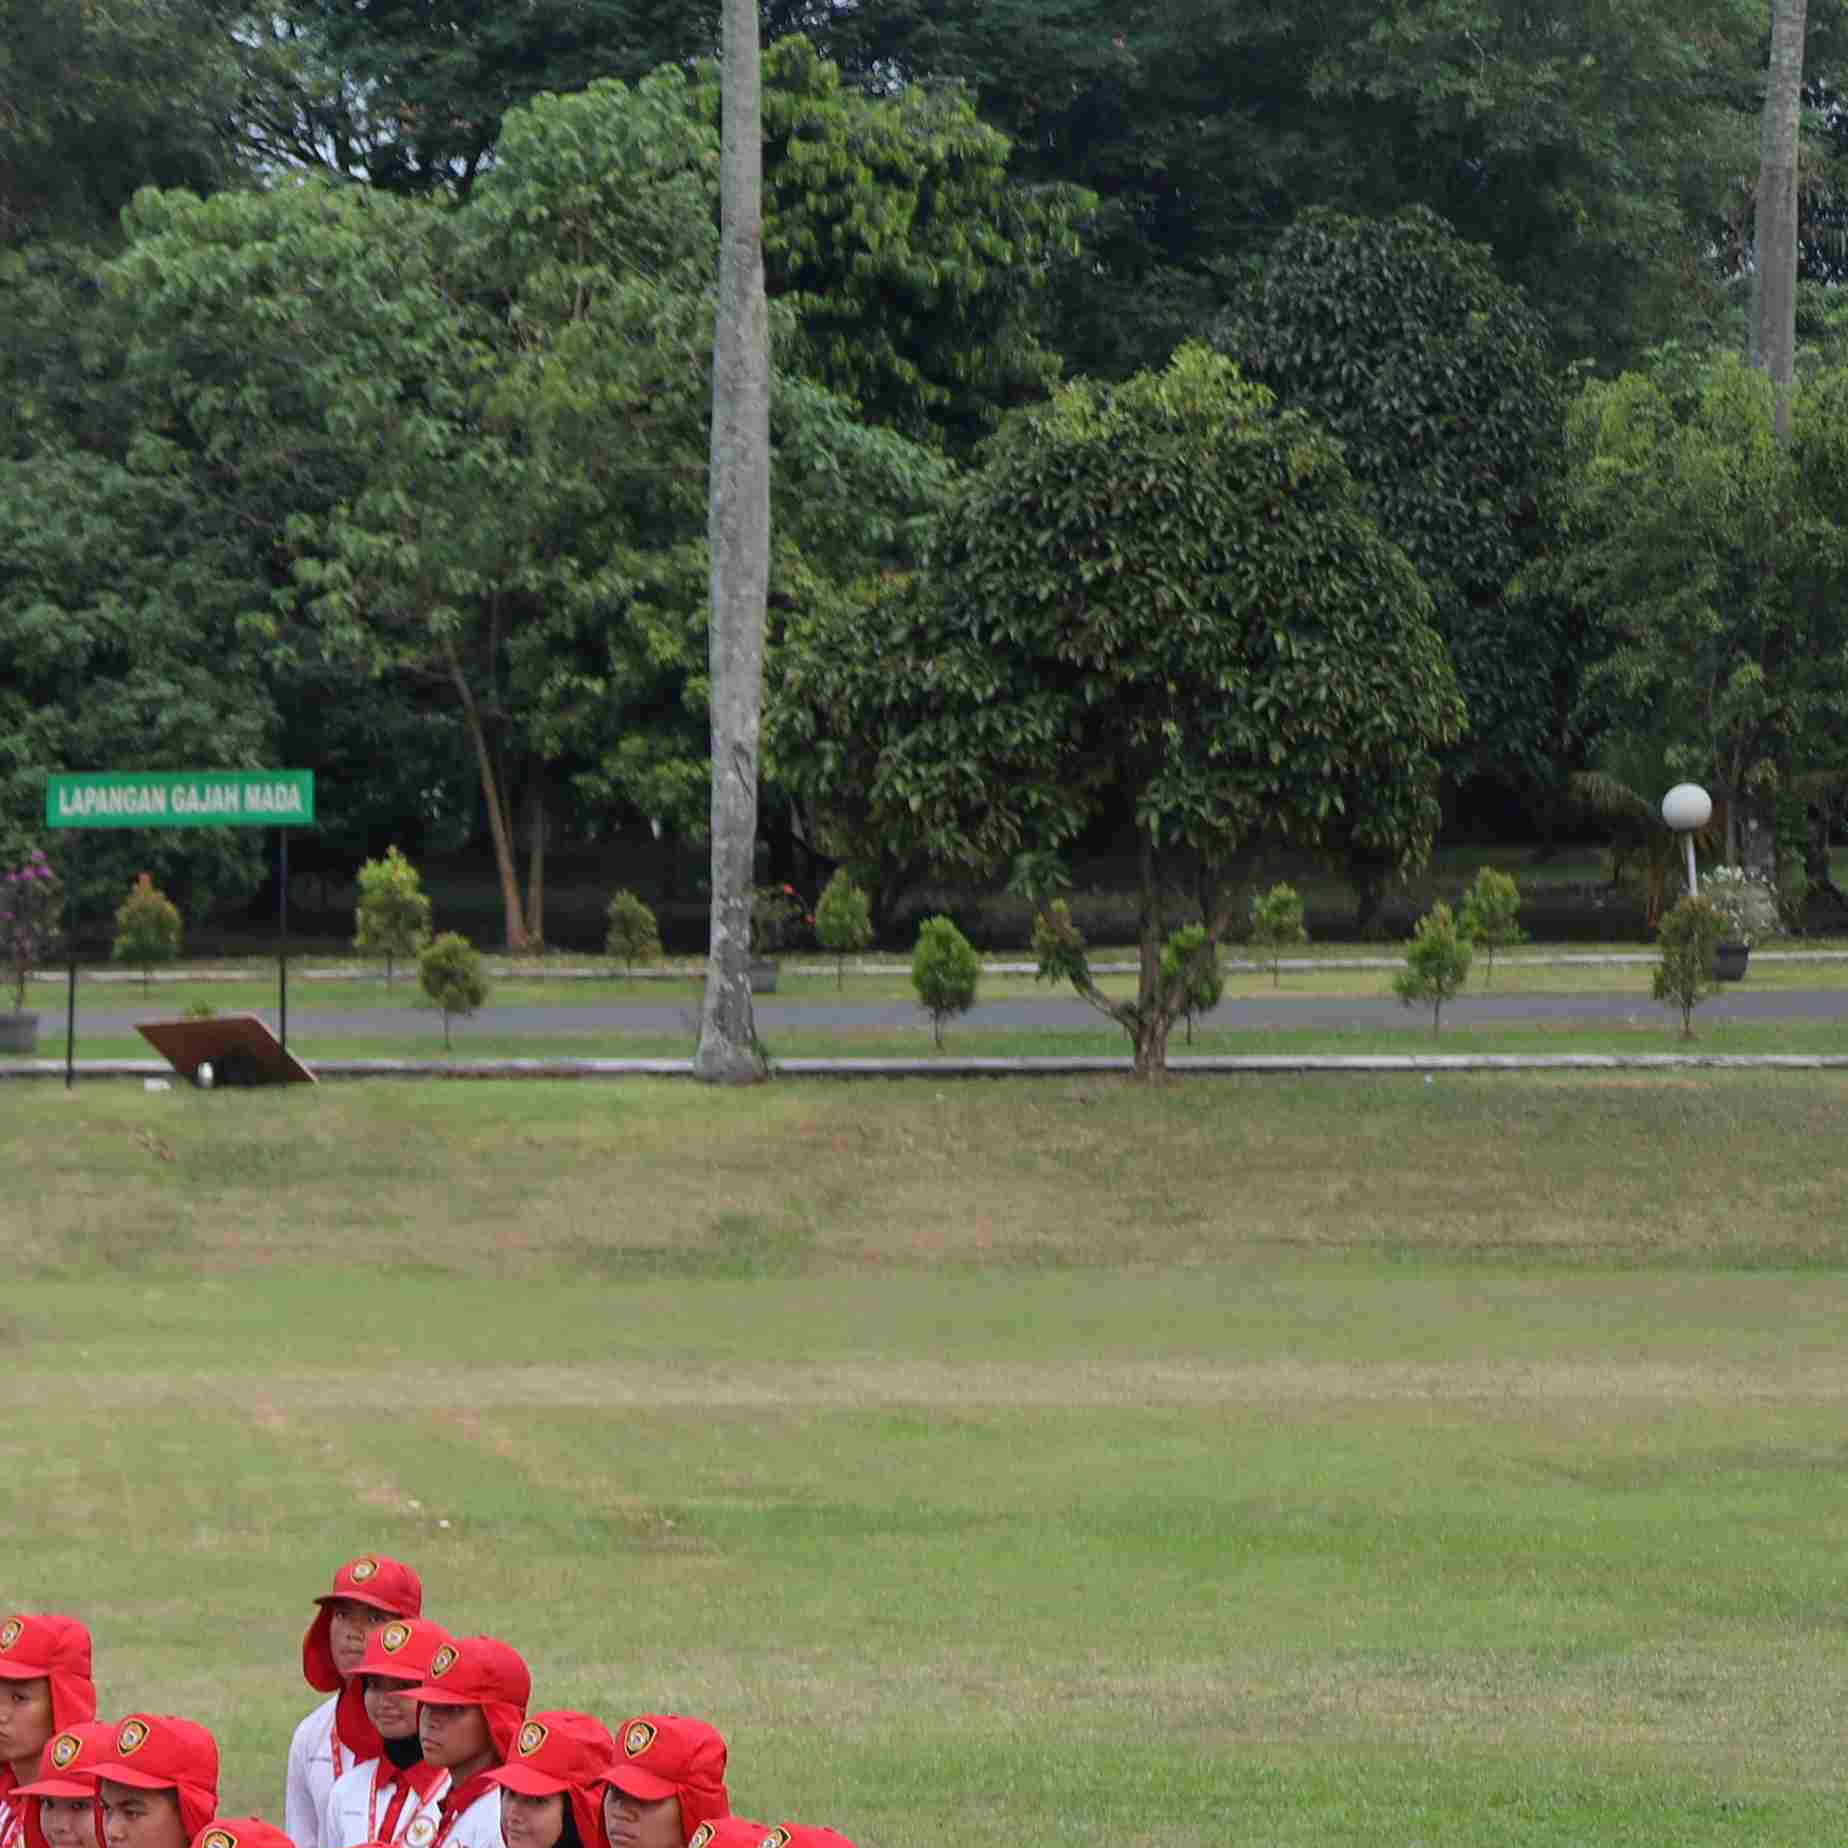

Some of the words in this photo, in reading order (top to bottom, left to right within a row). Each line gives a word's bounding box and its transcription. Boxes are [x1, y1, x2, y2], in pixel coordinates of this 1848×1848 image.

[59, 783, 166, 816] LAPANGAN
[171, 783, 240, 813] GAJAH
[244, 782, 304, 812] MADA
